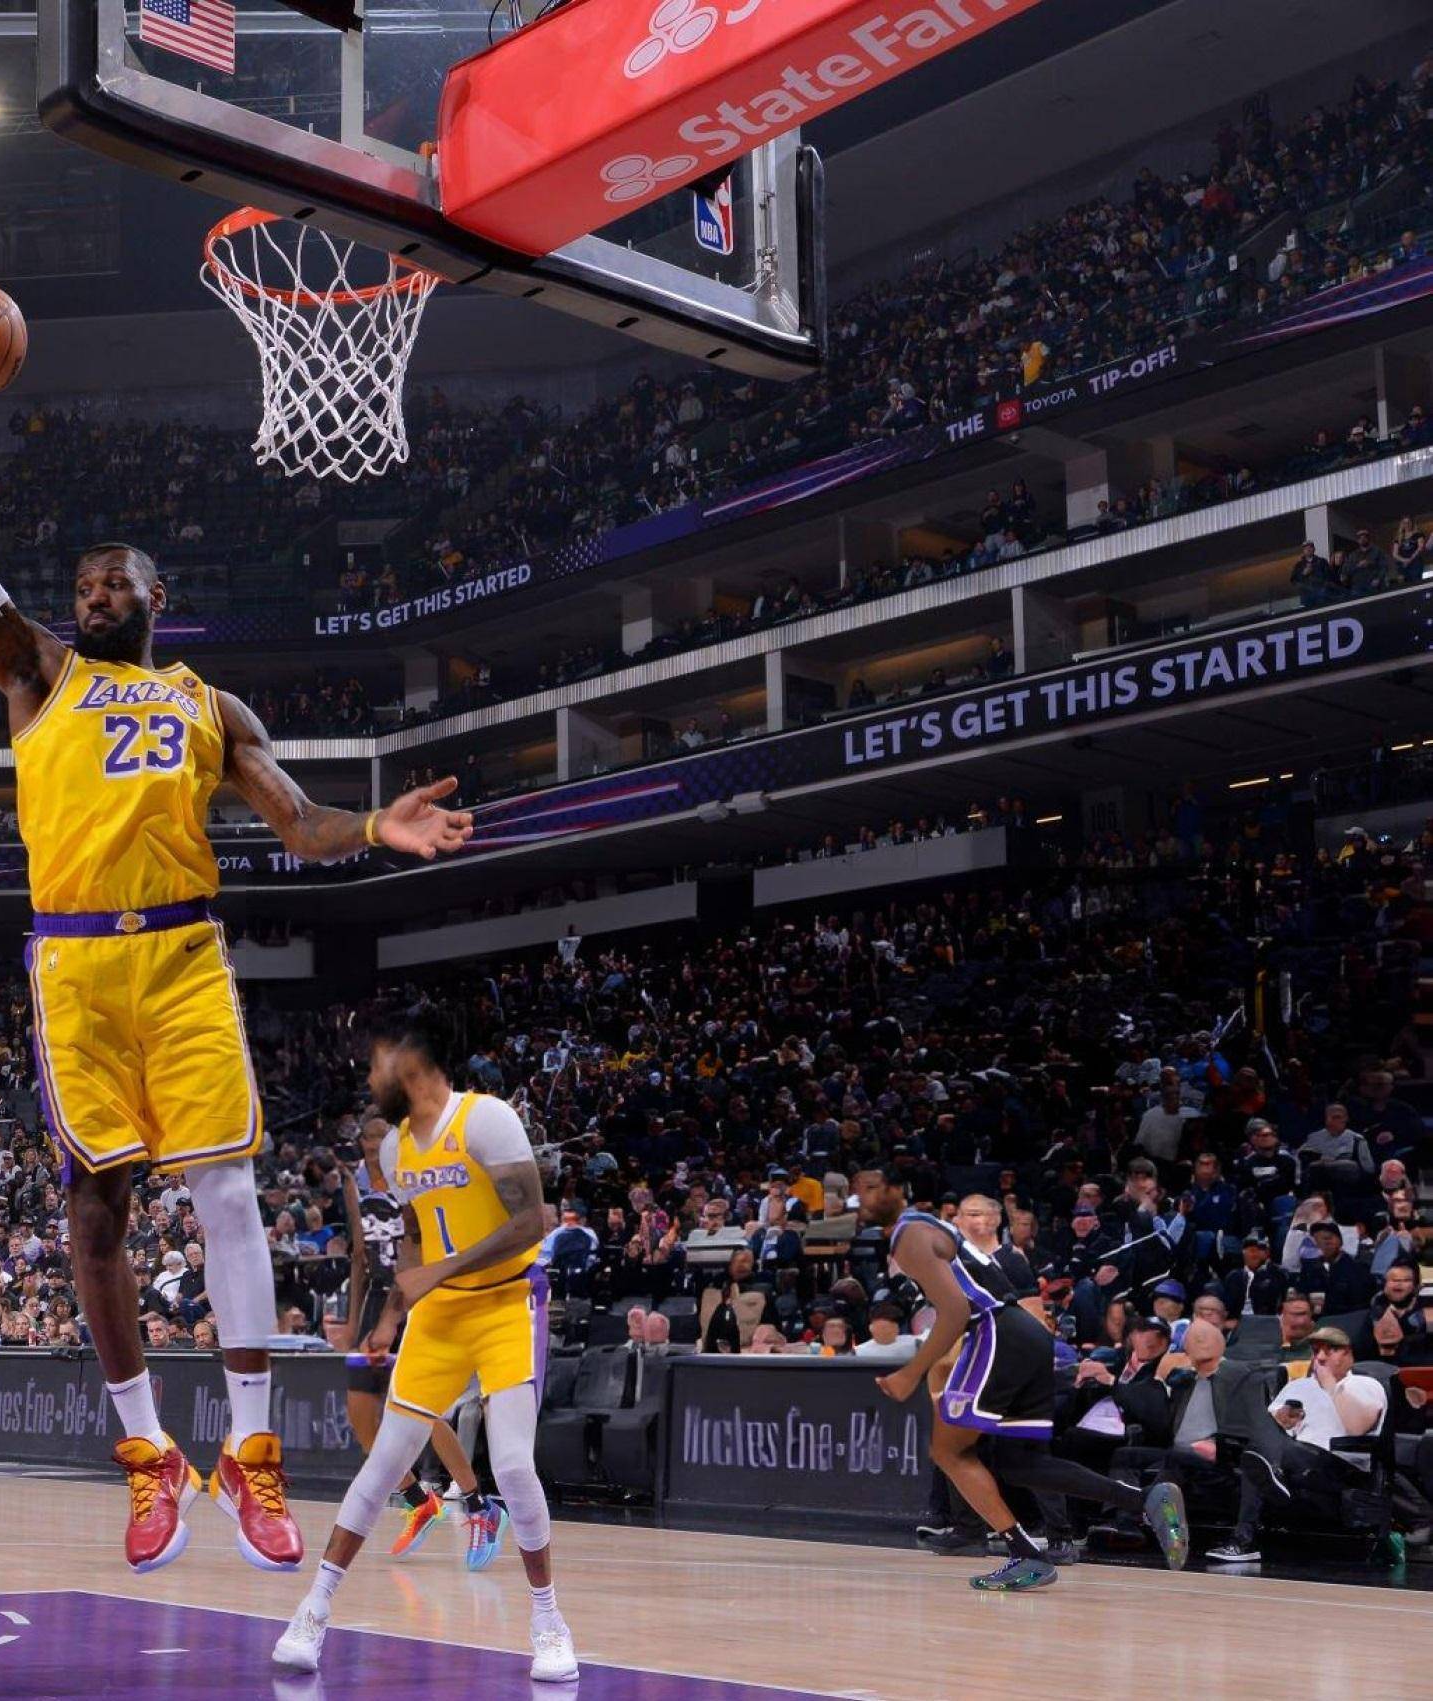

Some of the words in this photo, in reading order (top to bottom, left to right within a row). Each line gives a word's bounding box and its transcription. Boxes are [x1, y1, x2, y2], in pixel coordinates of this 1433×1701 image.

[678, 0, 1009, 157] StateFar
[700, 219, 721, 244] NBA
[946, 413, 985, 442] THE
[1023, 387, 1077, 413] TOYOTA
[1089, 345, 1177, 395] TIP-OFF!
[315, 611, 372, 635] LET'S
[376, 602, 412, 628] GET
[414, 588, 451, 618] THIS
[455, 564, 531, 604] STARTED
[73, 675, 200, 720] LAKERS
[844, 712, 943, 765] LET'S
[951, 689, 1031, 738] GET
[1040, 667, 1139, 722] THIS
[1150, 617, 1364, 698] STARTED
[104, 714, 187, 778] 23
[434, 1206, 458, 1258] 1
